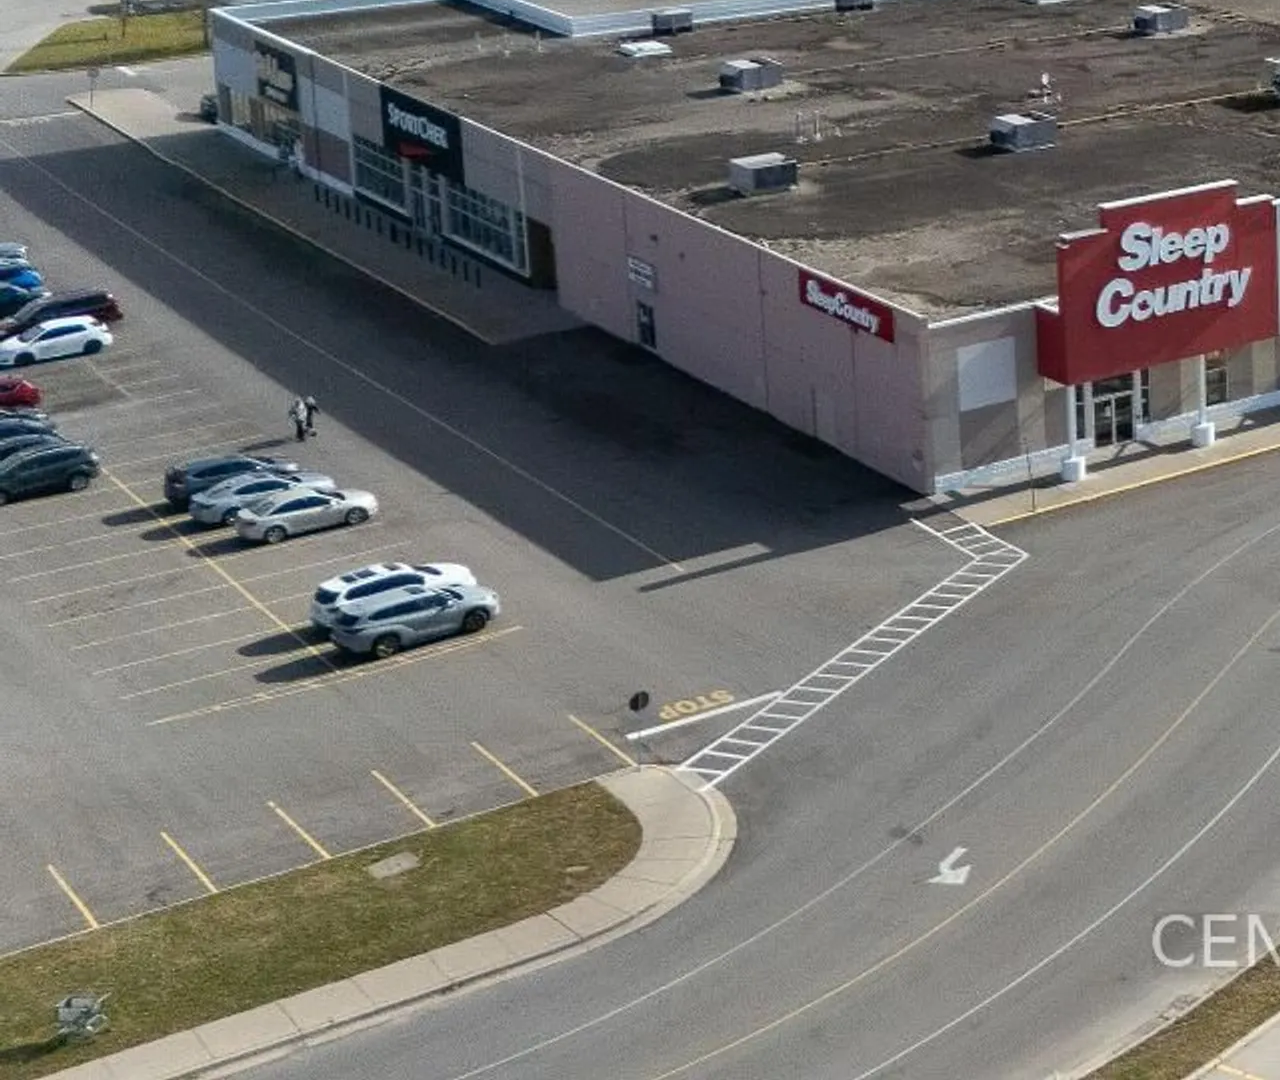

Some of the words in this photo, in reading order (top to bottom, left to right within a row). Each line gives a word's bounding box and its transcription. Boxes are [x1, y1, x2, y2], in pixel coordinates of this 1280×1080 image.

[1118, 222, 1229, 271] Sleep
[1096, 267, 1252, 327] Country
[659, 689, 735, 720] STOP
